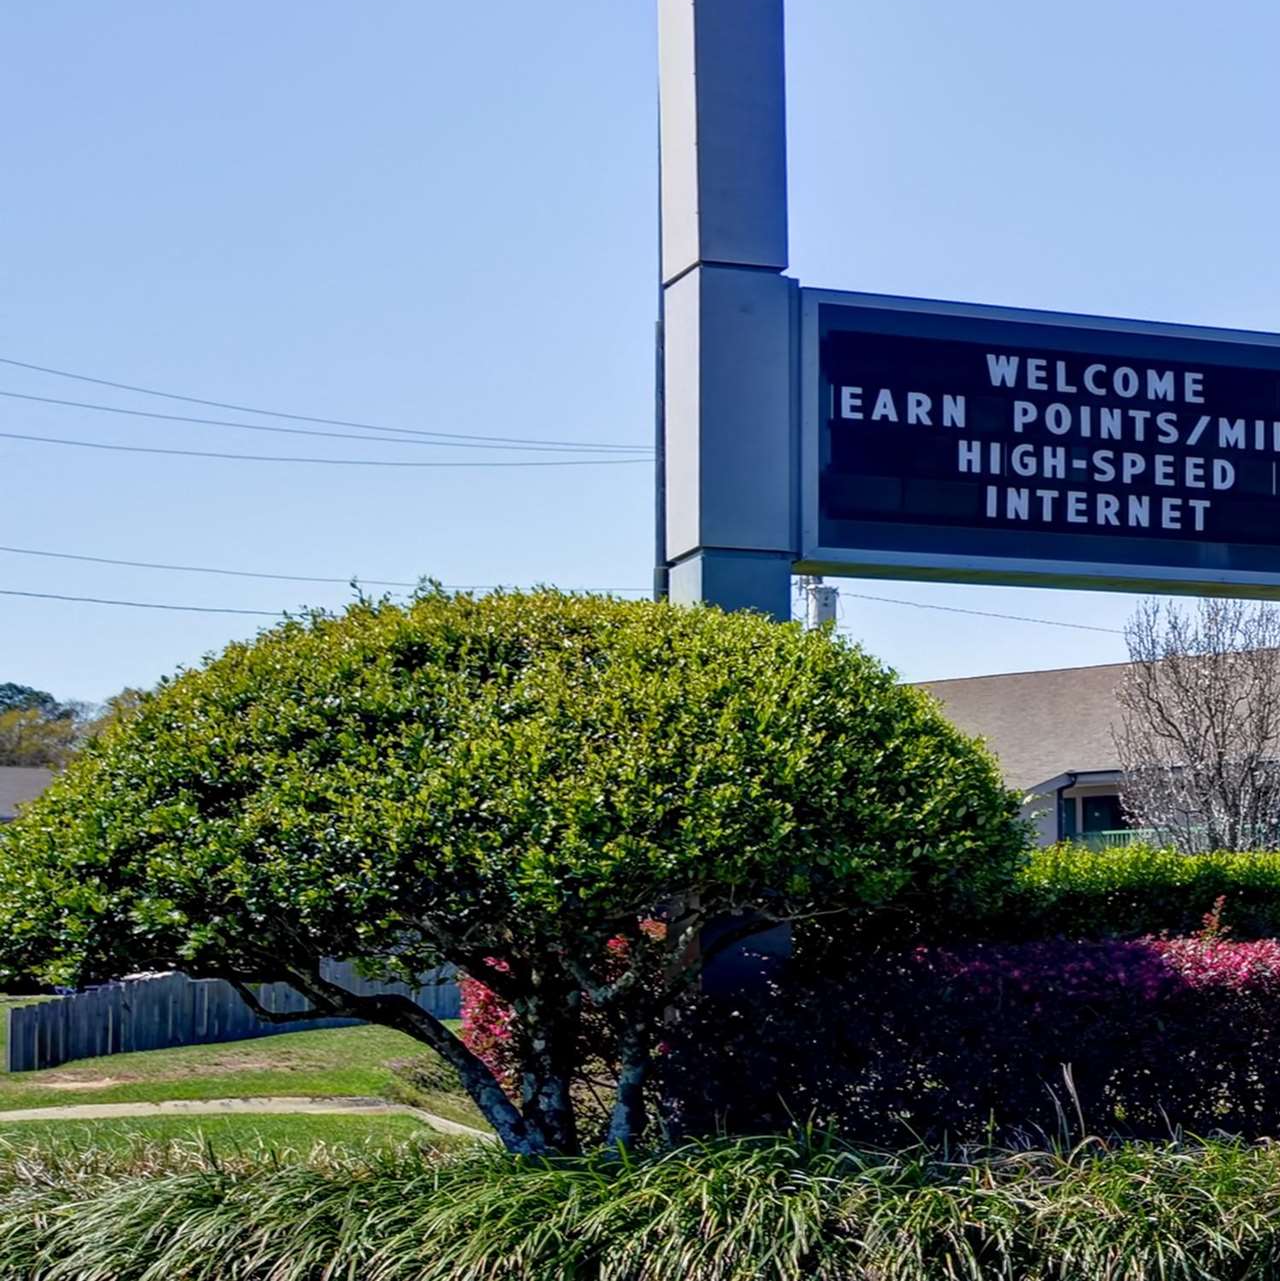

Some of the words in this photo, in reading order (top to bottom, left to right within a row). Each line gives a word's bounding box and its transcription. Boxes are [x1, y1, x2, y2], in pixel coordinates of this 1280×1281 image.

[985, 352, 1206, 405] WELCOME
[839, 385, 967, 428] EARN
[957, 439, 1237, 491] HIGH-SPEED
[986, 485, 1212, 532] INTERNET
